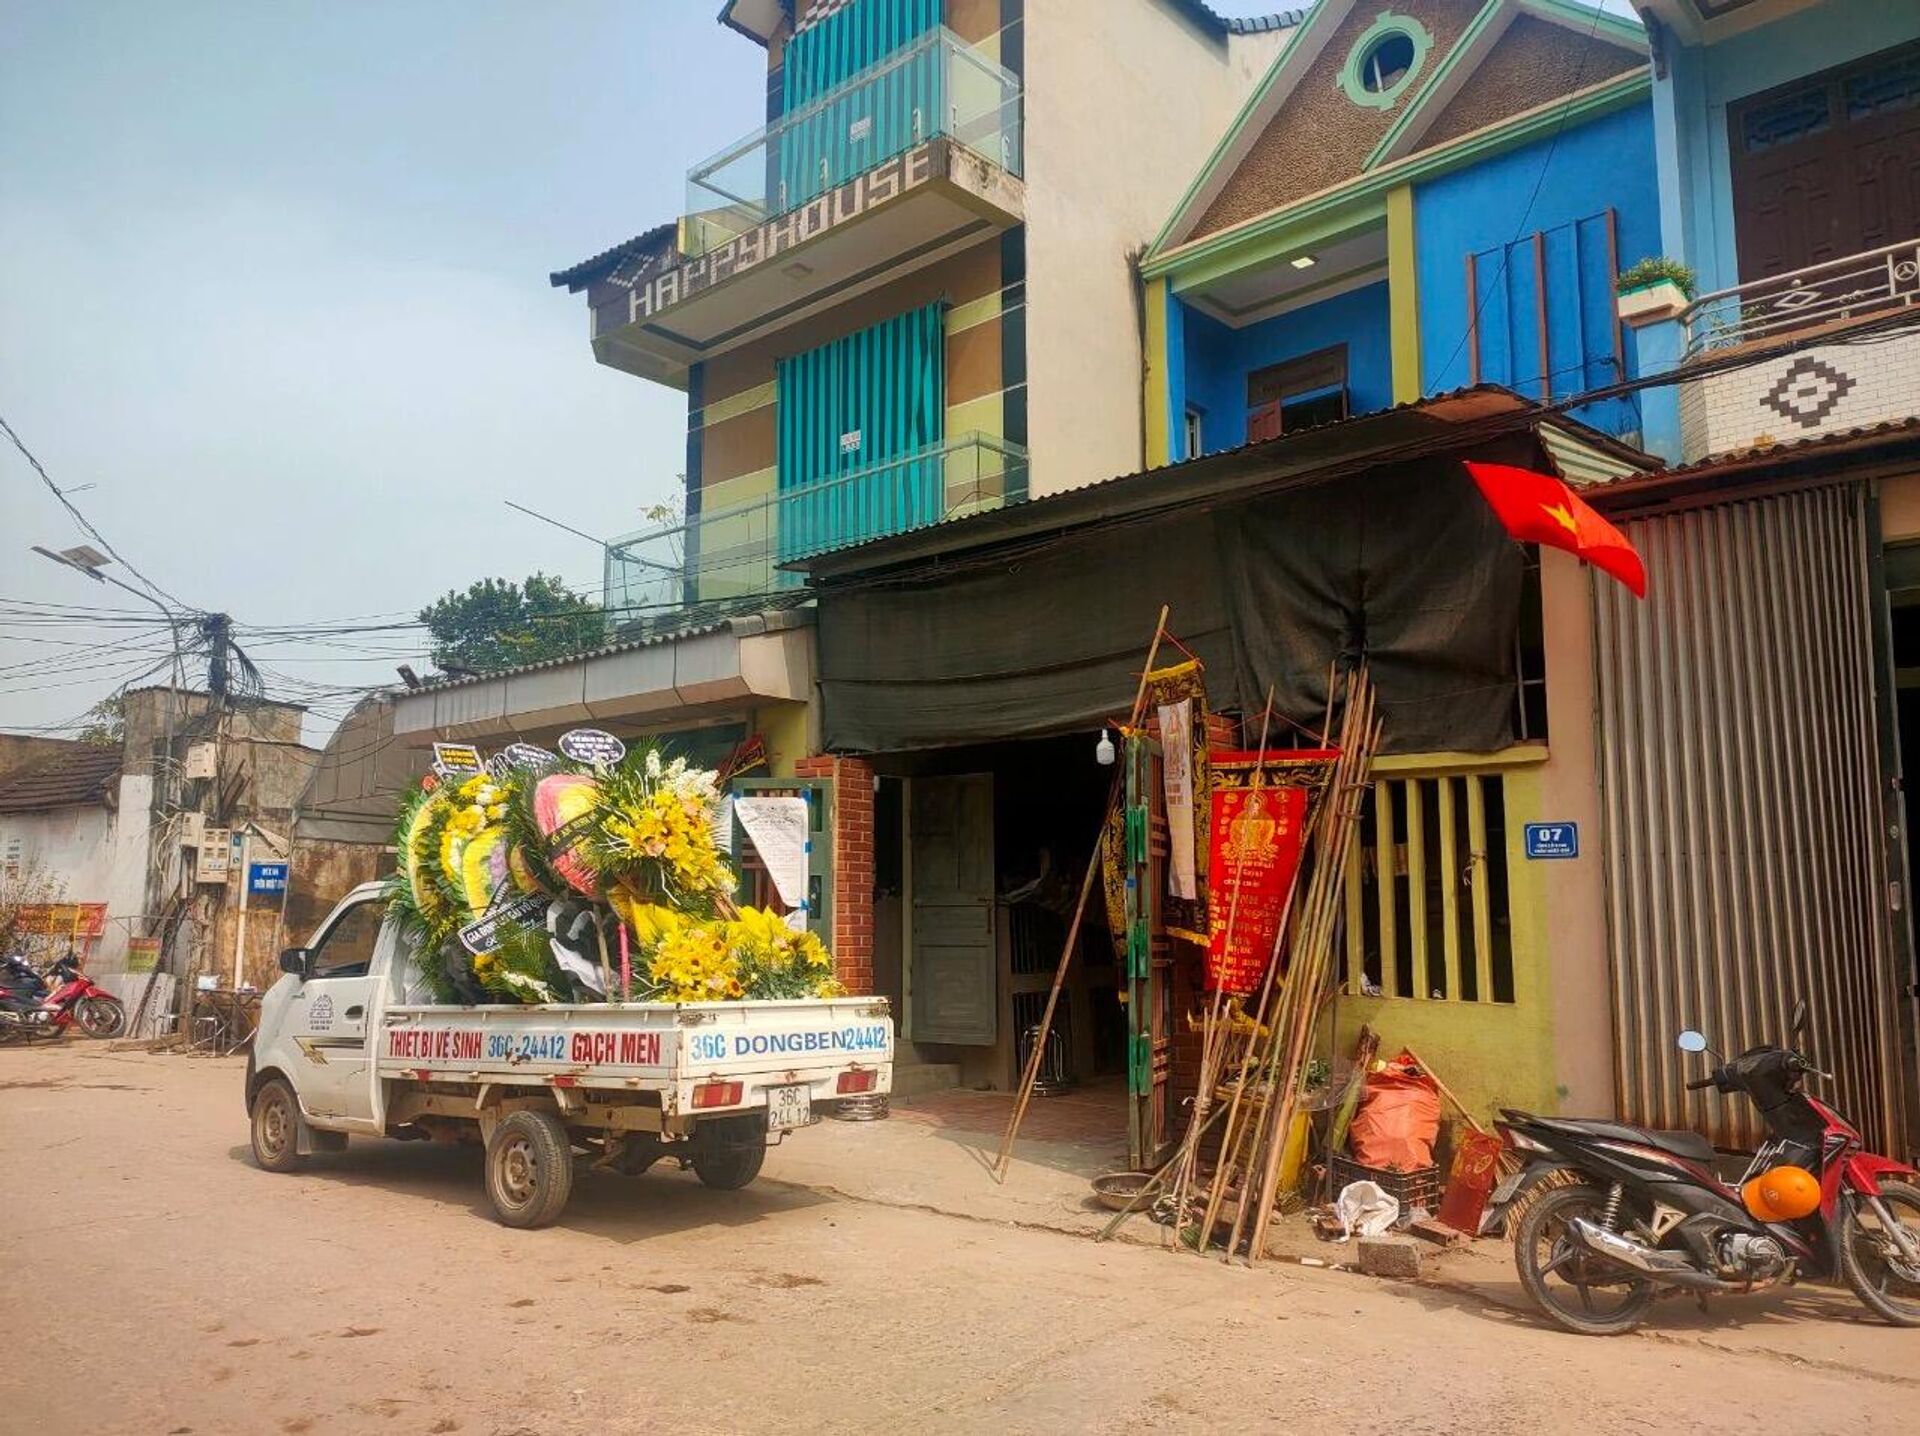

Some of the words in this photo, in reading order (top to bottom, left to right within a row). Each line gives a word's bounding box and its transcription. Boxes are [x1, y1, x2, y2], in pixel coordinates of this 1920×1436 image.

[1539, 828, 1563, 842] 07
[452, 1031, 482, 1059] SINH
[620, 1032, 660, 1064] MEN
[691, 1033, 727, 1061] 36C
[735, 1031, 846, 1055] DONGBEN
[846, 1026, 887, 1050] 24412
[778, 1087, 801, 1107] 36C
